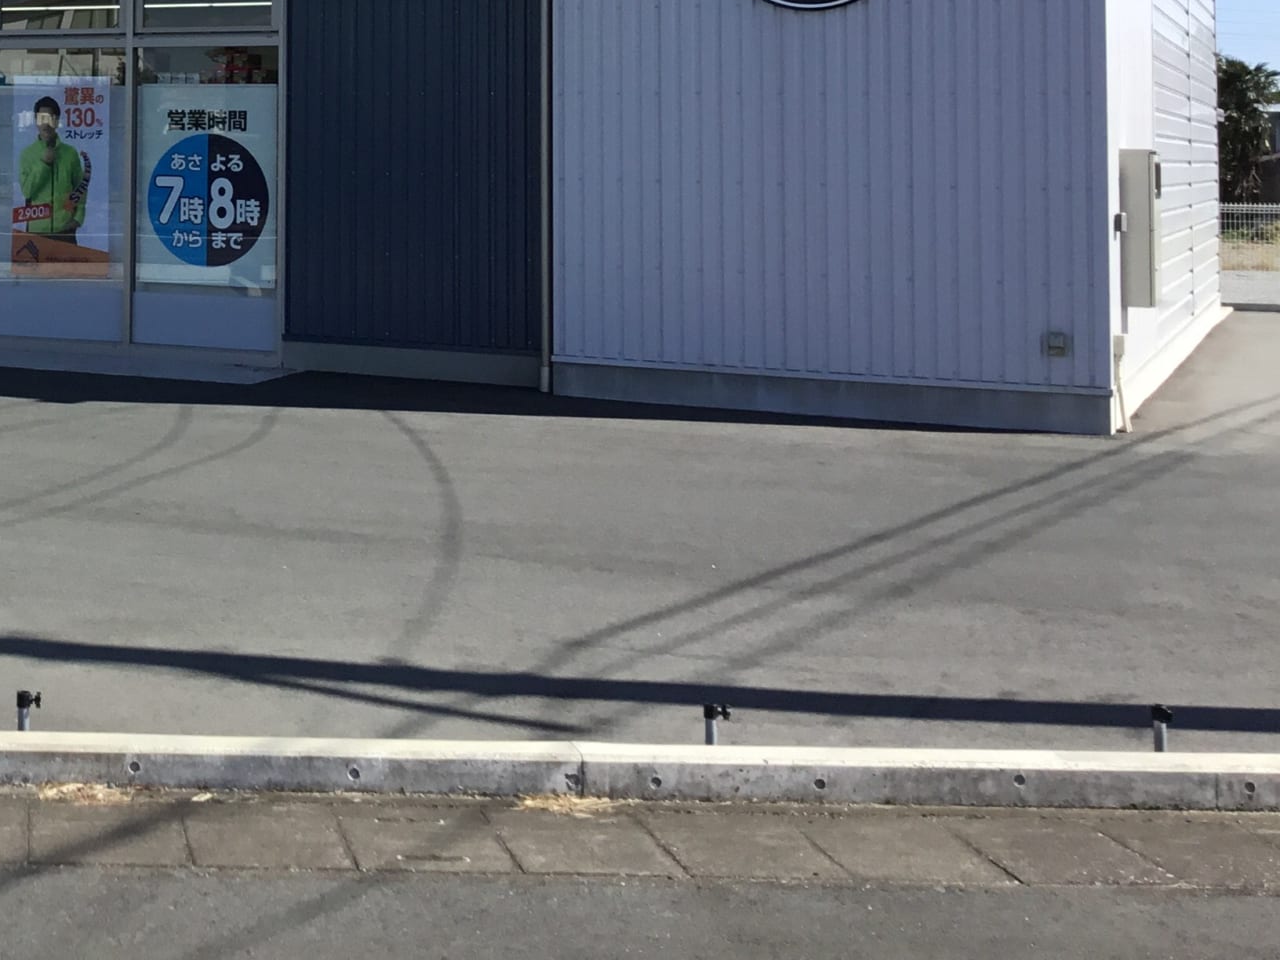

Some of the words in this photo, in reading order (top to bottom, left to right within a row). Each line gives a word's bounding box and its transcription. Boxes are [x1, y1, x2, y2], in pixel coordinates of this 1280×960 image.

[167, 109, 248, 132] 営業時間
[64, 129, 104, 140] ストレッチ
[171, 153, 203, 171] あさ
[210, 153, 244, 171] よる
[155, 175, 205, 225] 7時
[208, 177, 261, 229] 8時
[172, 230, 203, 248] から
[210, 232, 243, 250] まで
